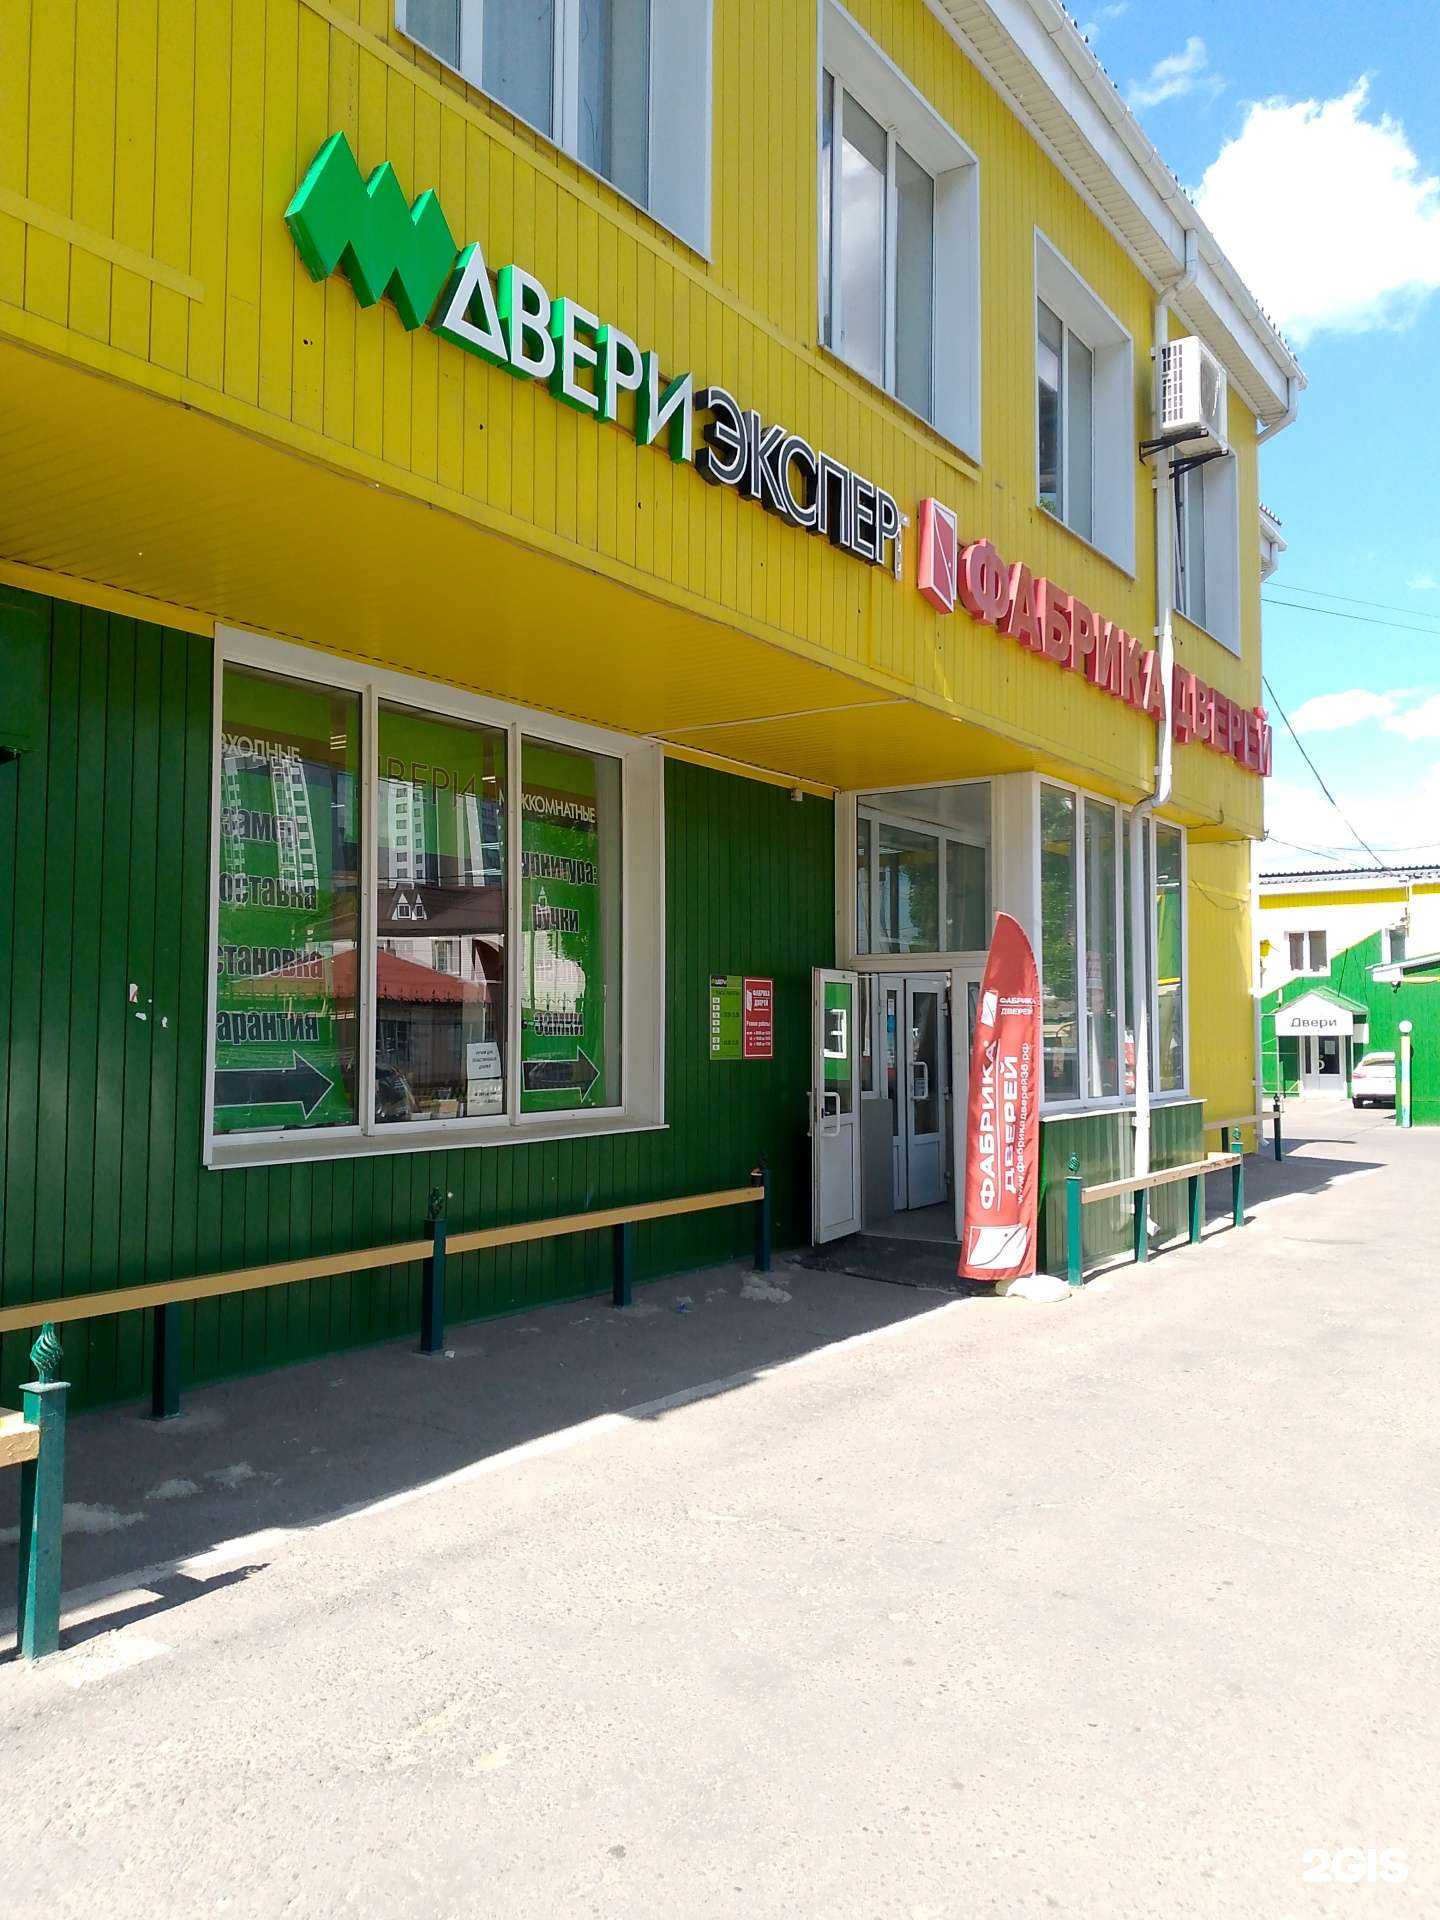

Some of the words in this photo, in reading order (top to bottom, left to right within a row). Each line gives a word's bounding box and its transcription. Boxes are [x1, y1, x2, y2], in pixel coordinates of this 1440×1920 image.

[958, 538, 1166, 722] ФАБРИКА
[1172, 662, 1273, 777] ДВЕРЕЙ
[219, 871, 318, 911] оставка
[1290, 1017, 1337, 1029] Двери
[979, 1039, 998, 1210] ФАБРИКА
[1000, 1056, 1018, 1195] ДВЕРЕЙ
